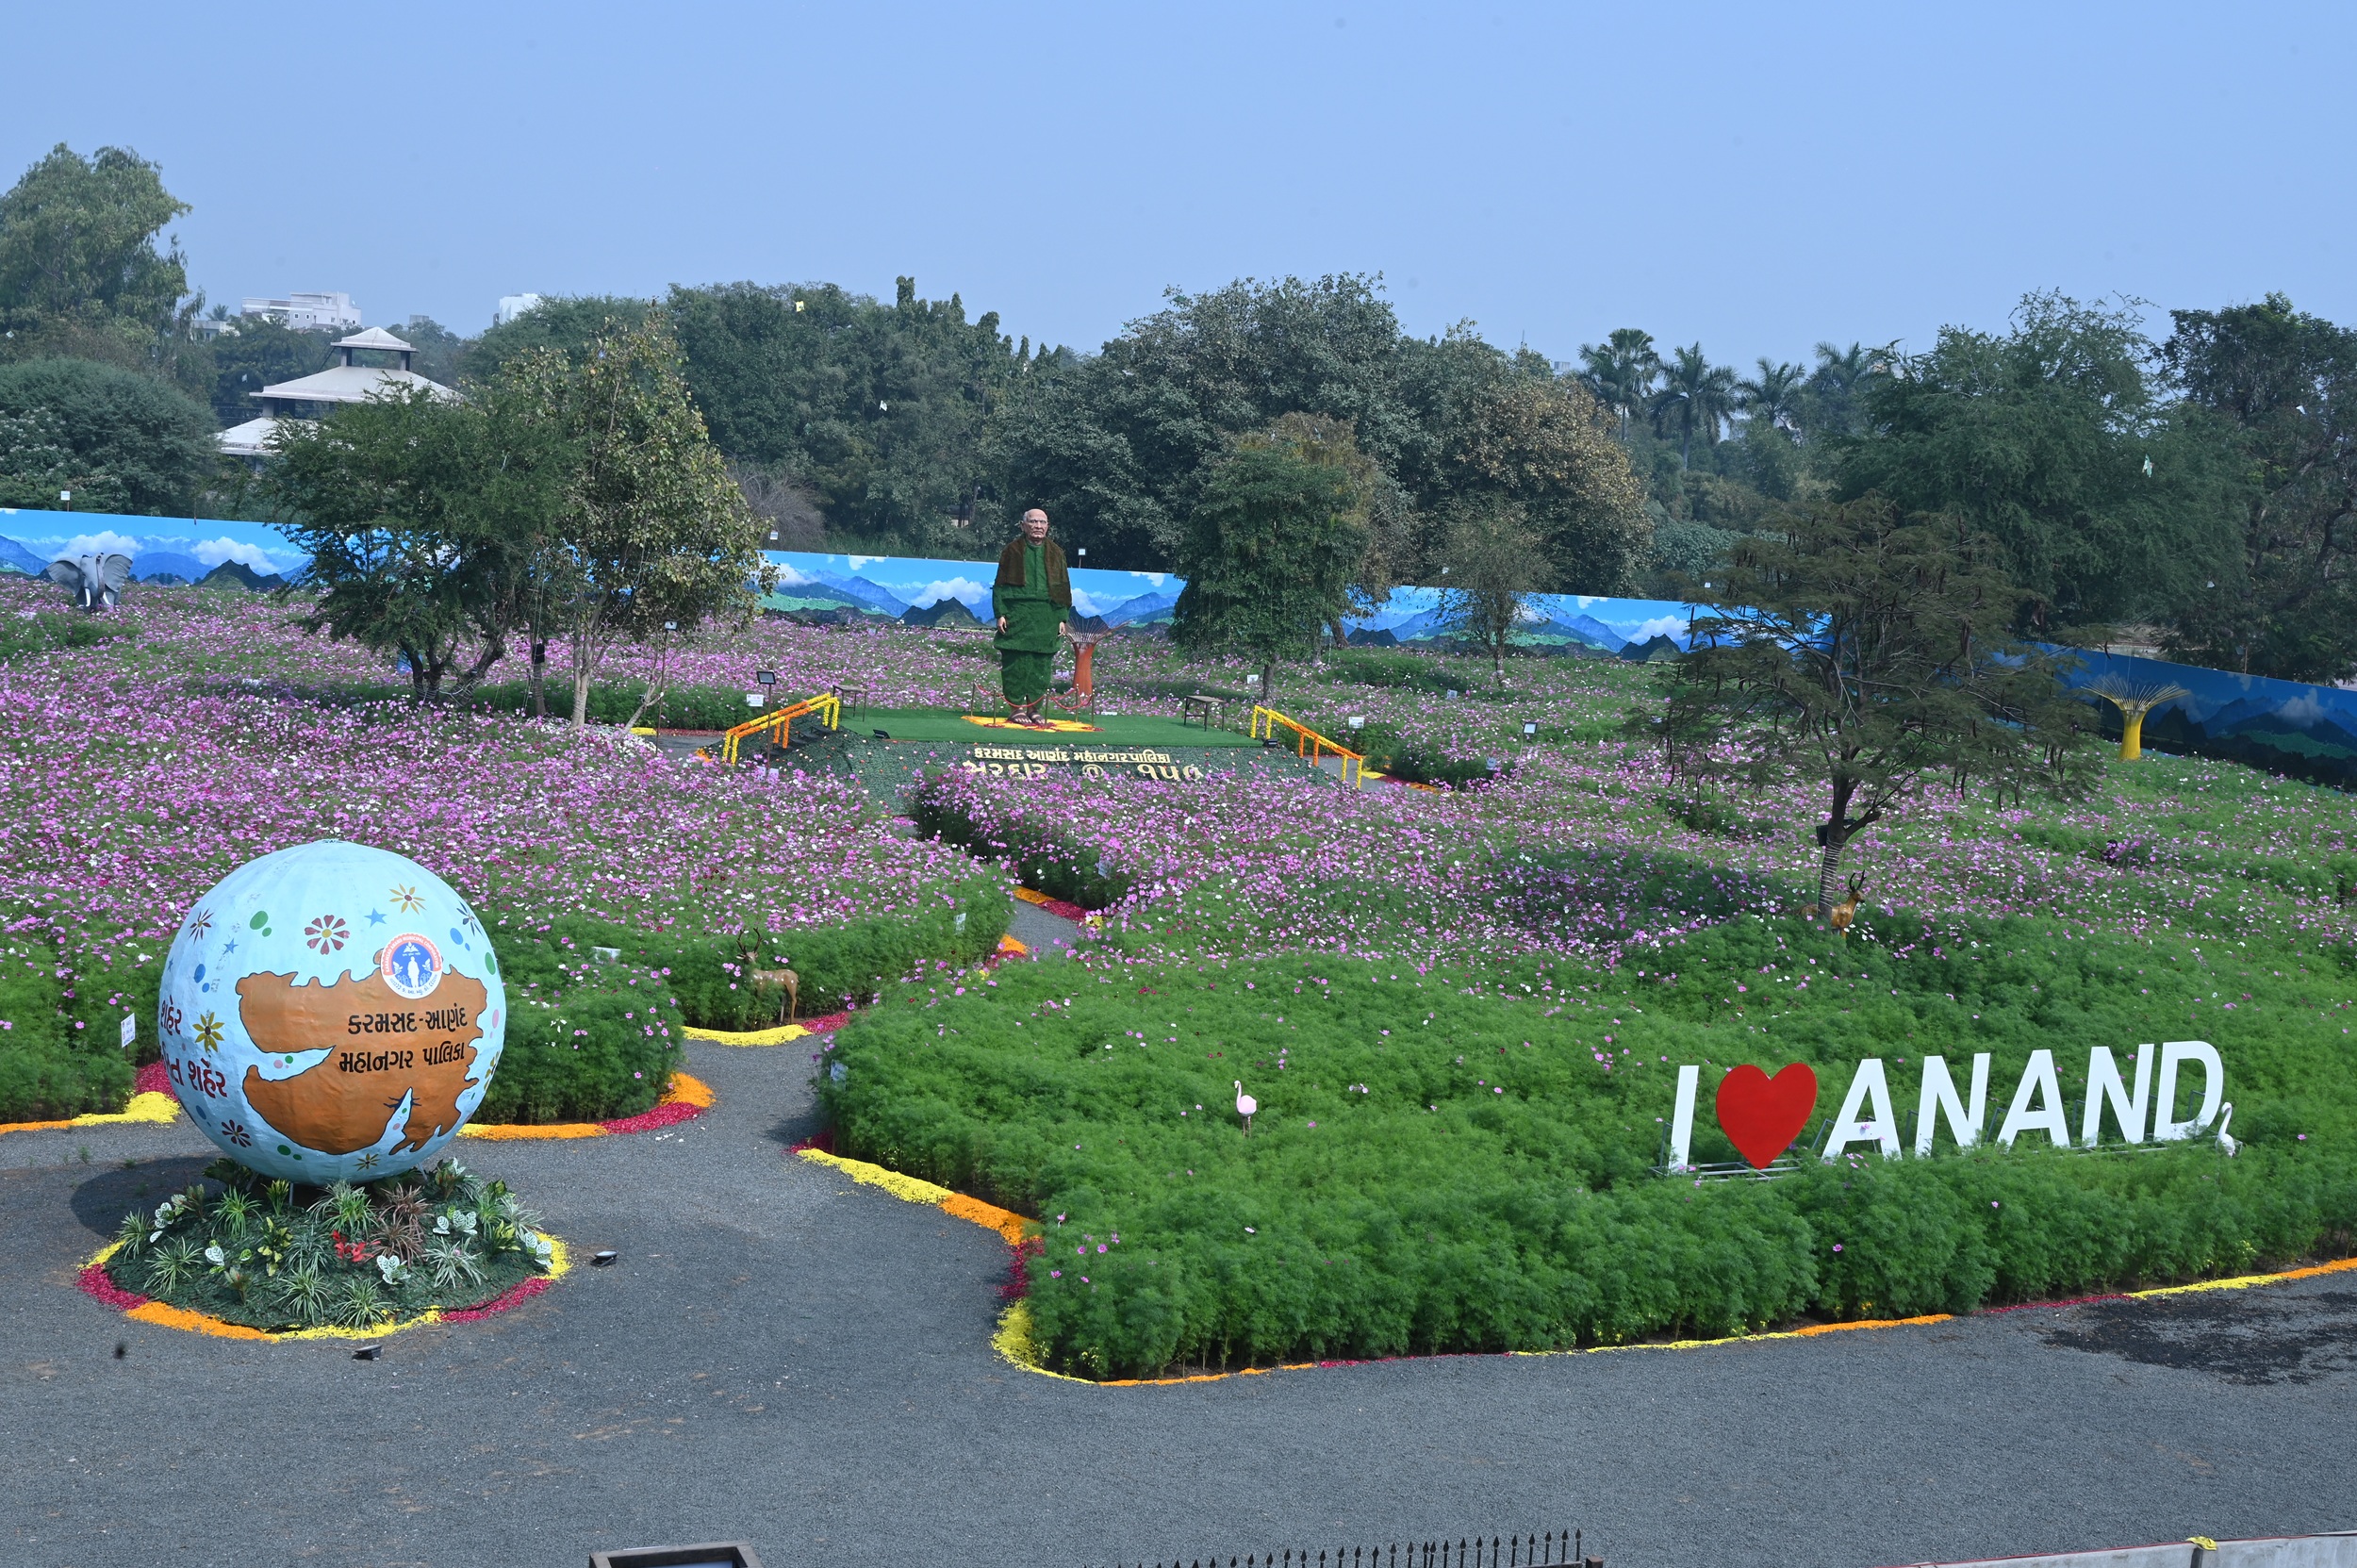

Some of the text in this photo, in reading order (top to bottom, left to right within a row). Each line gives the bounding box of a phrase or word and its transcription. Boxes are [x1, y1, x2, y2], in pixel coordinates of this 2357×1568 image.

[974, 748, 1024, 760] કરમસદ
[339, 1041, 465, 1073] મહાનગર પાલિકા
[188, 1057, 227, 1098] શહેર
[1668, 1040, 2224, 1175] I ANAND
